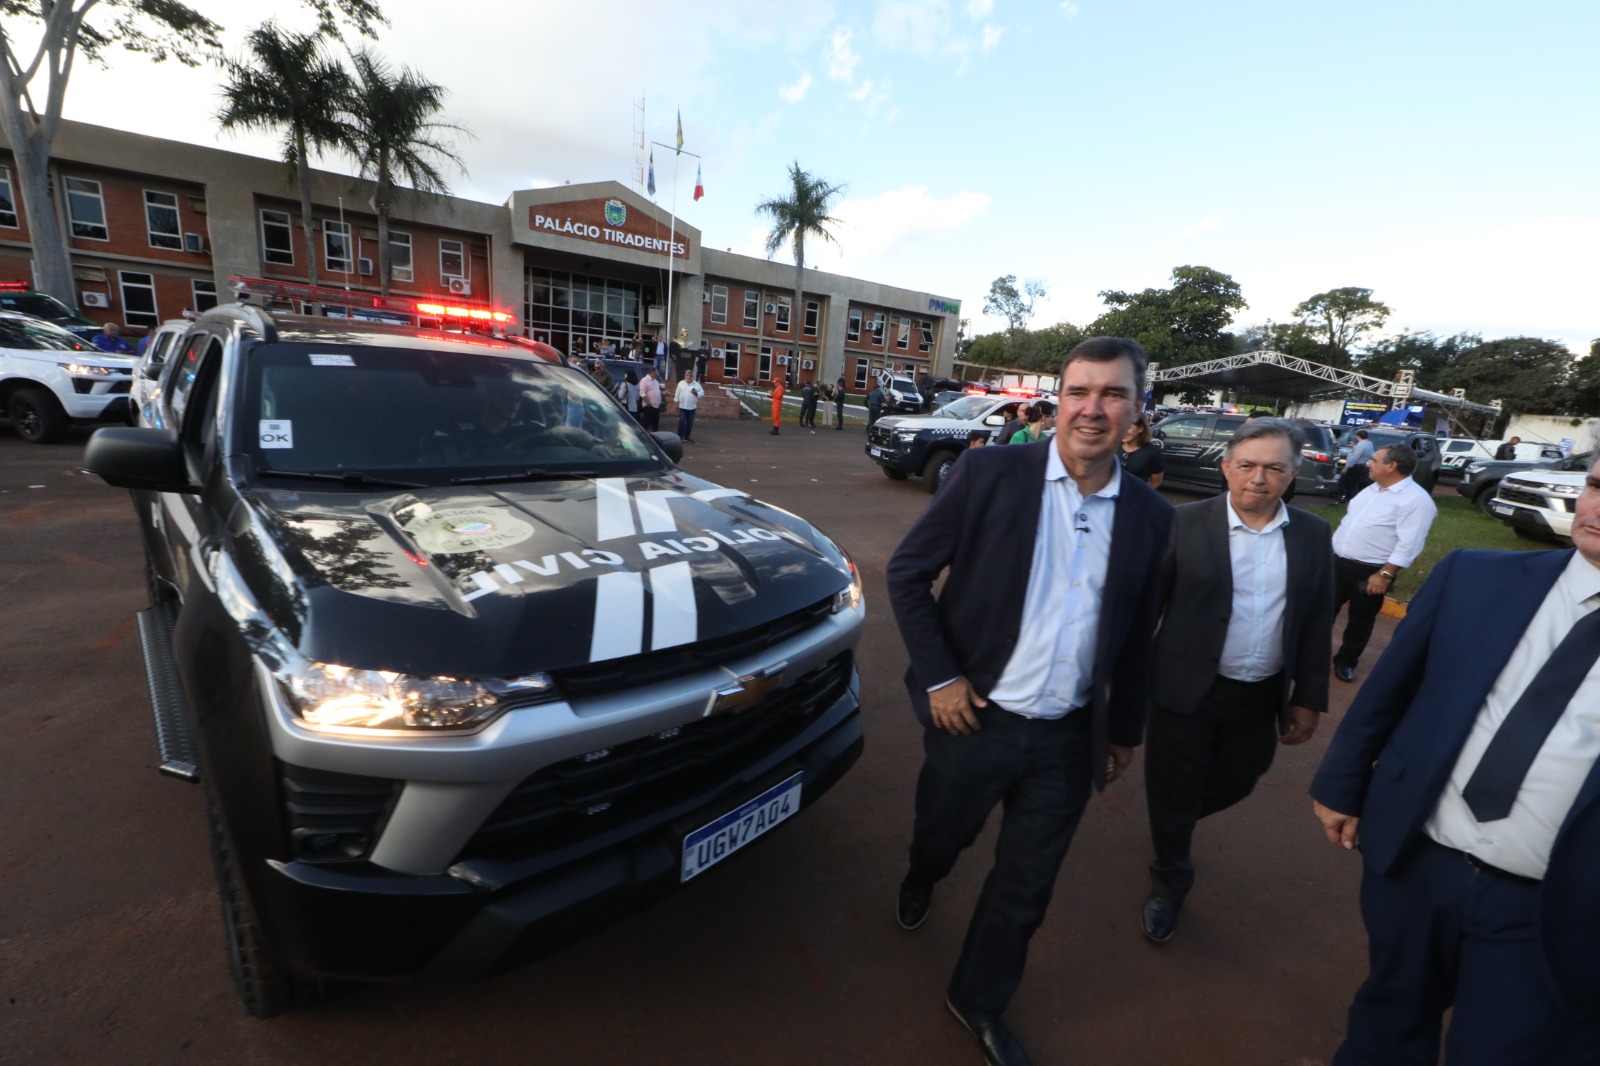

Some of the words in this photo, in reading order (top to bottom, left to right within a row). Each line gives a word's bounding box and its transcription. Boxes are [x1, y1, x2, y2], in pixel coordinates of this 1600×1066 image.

[535, 215, 600, 238] PALÁCIO
[603, 228, 685, 255] TIRADENTES
[260, 434, 290, 442] OK
[697, 794, 790, 868] UGW7A04
